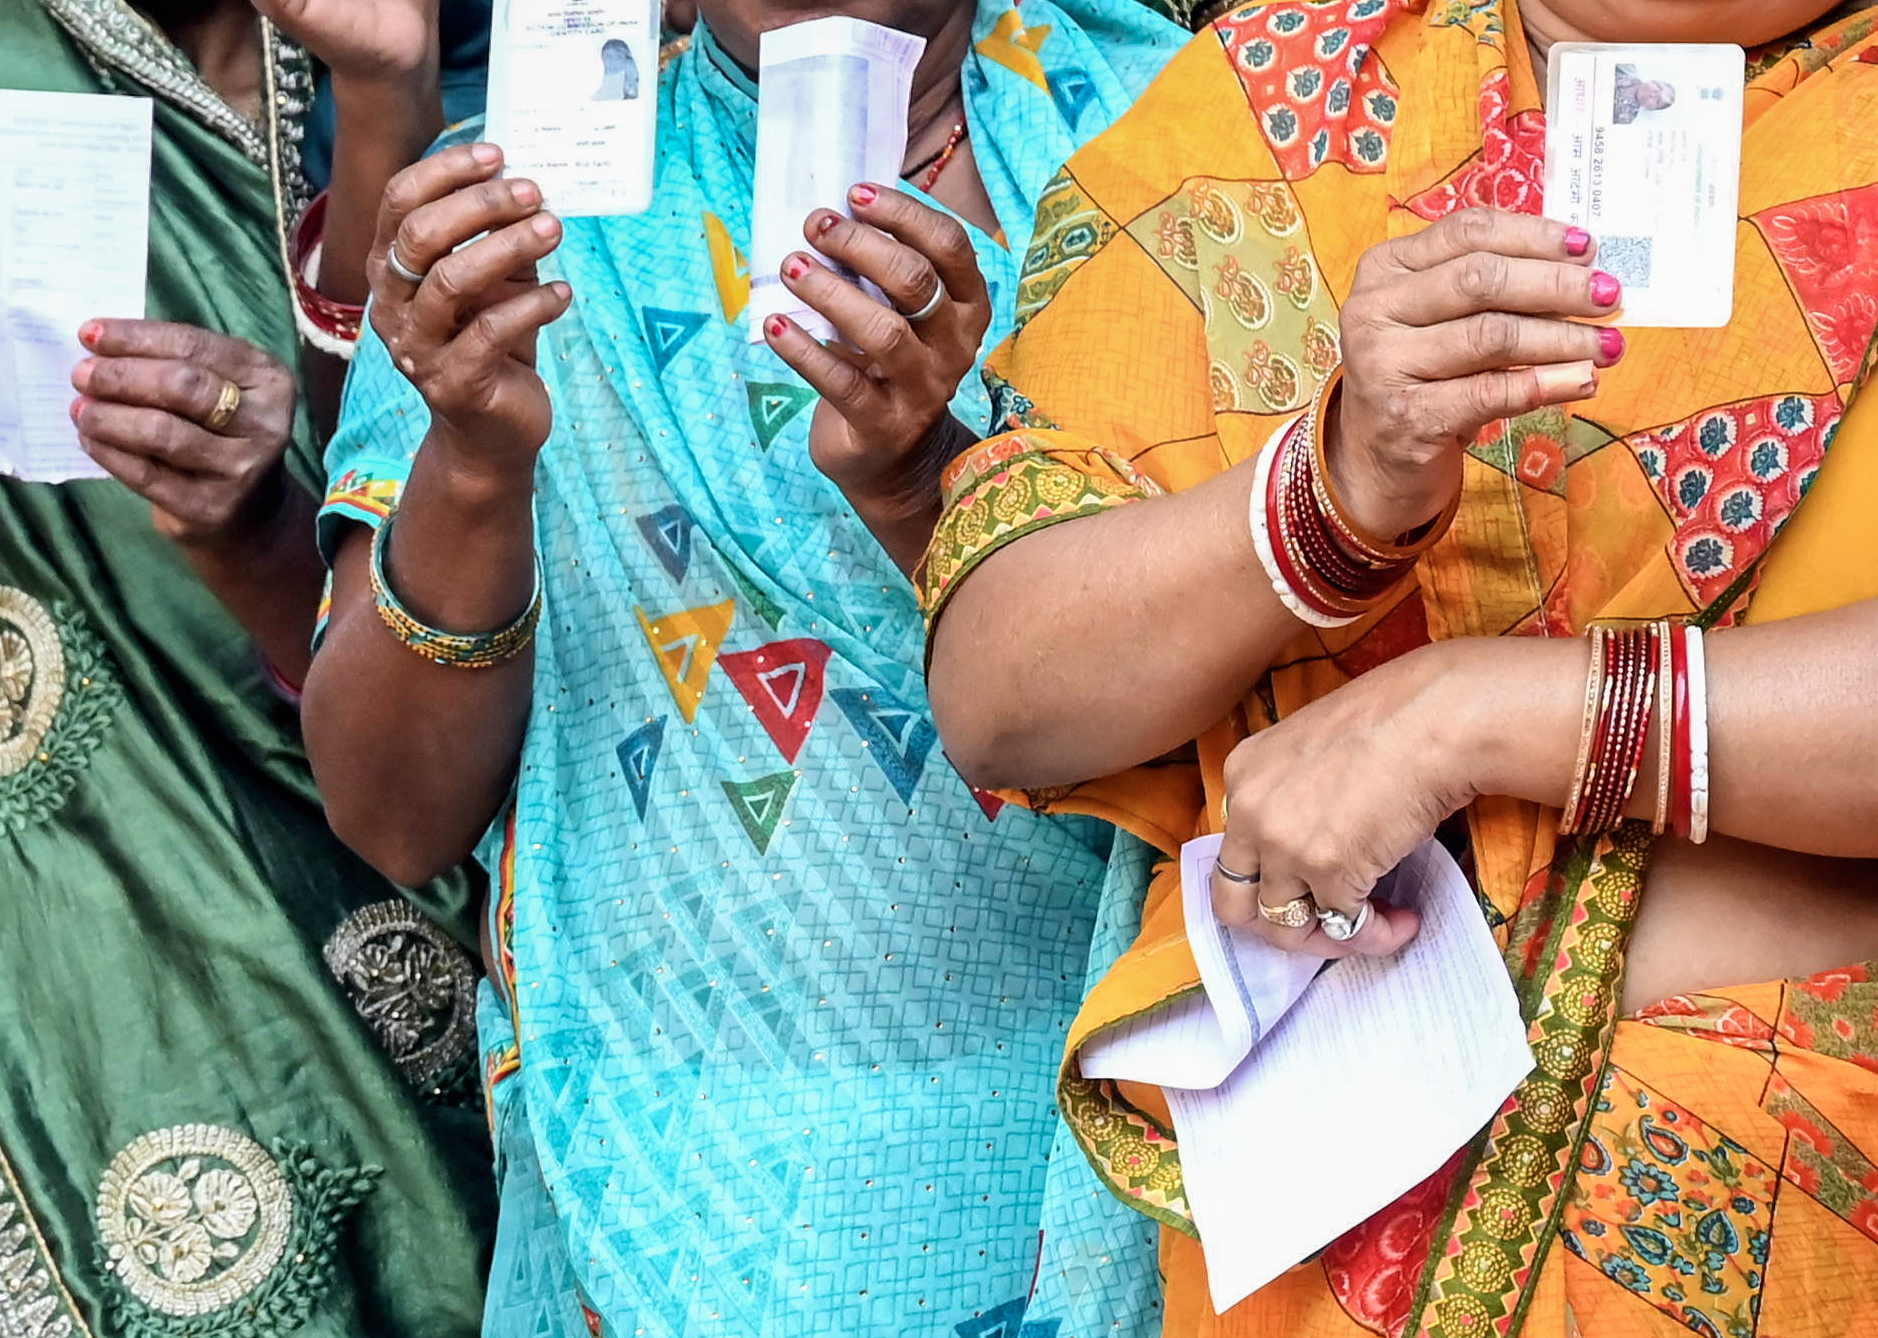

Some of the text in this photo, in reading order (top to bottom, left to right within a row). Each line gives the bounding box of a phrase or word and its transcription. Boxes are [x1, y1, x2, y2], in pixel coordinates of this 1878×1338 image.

[1572, 133, 1583, 157] आम
[1595, 127, 1605, 154] 9458
[1592, 189, 1603, 217] 0407
